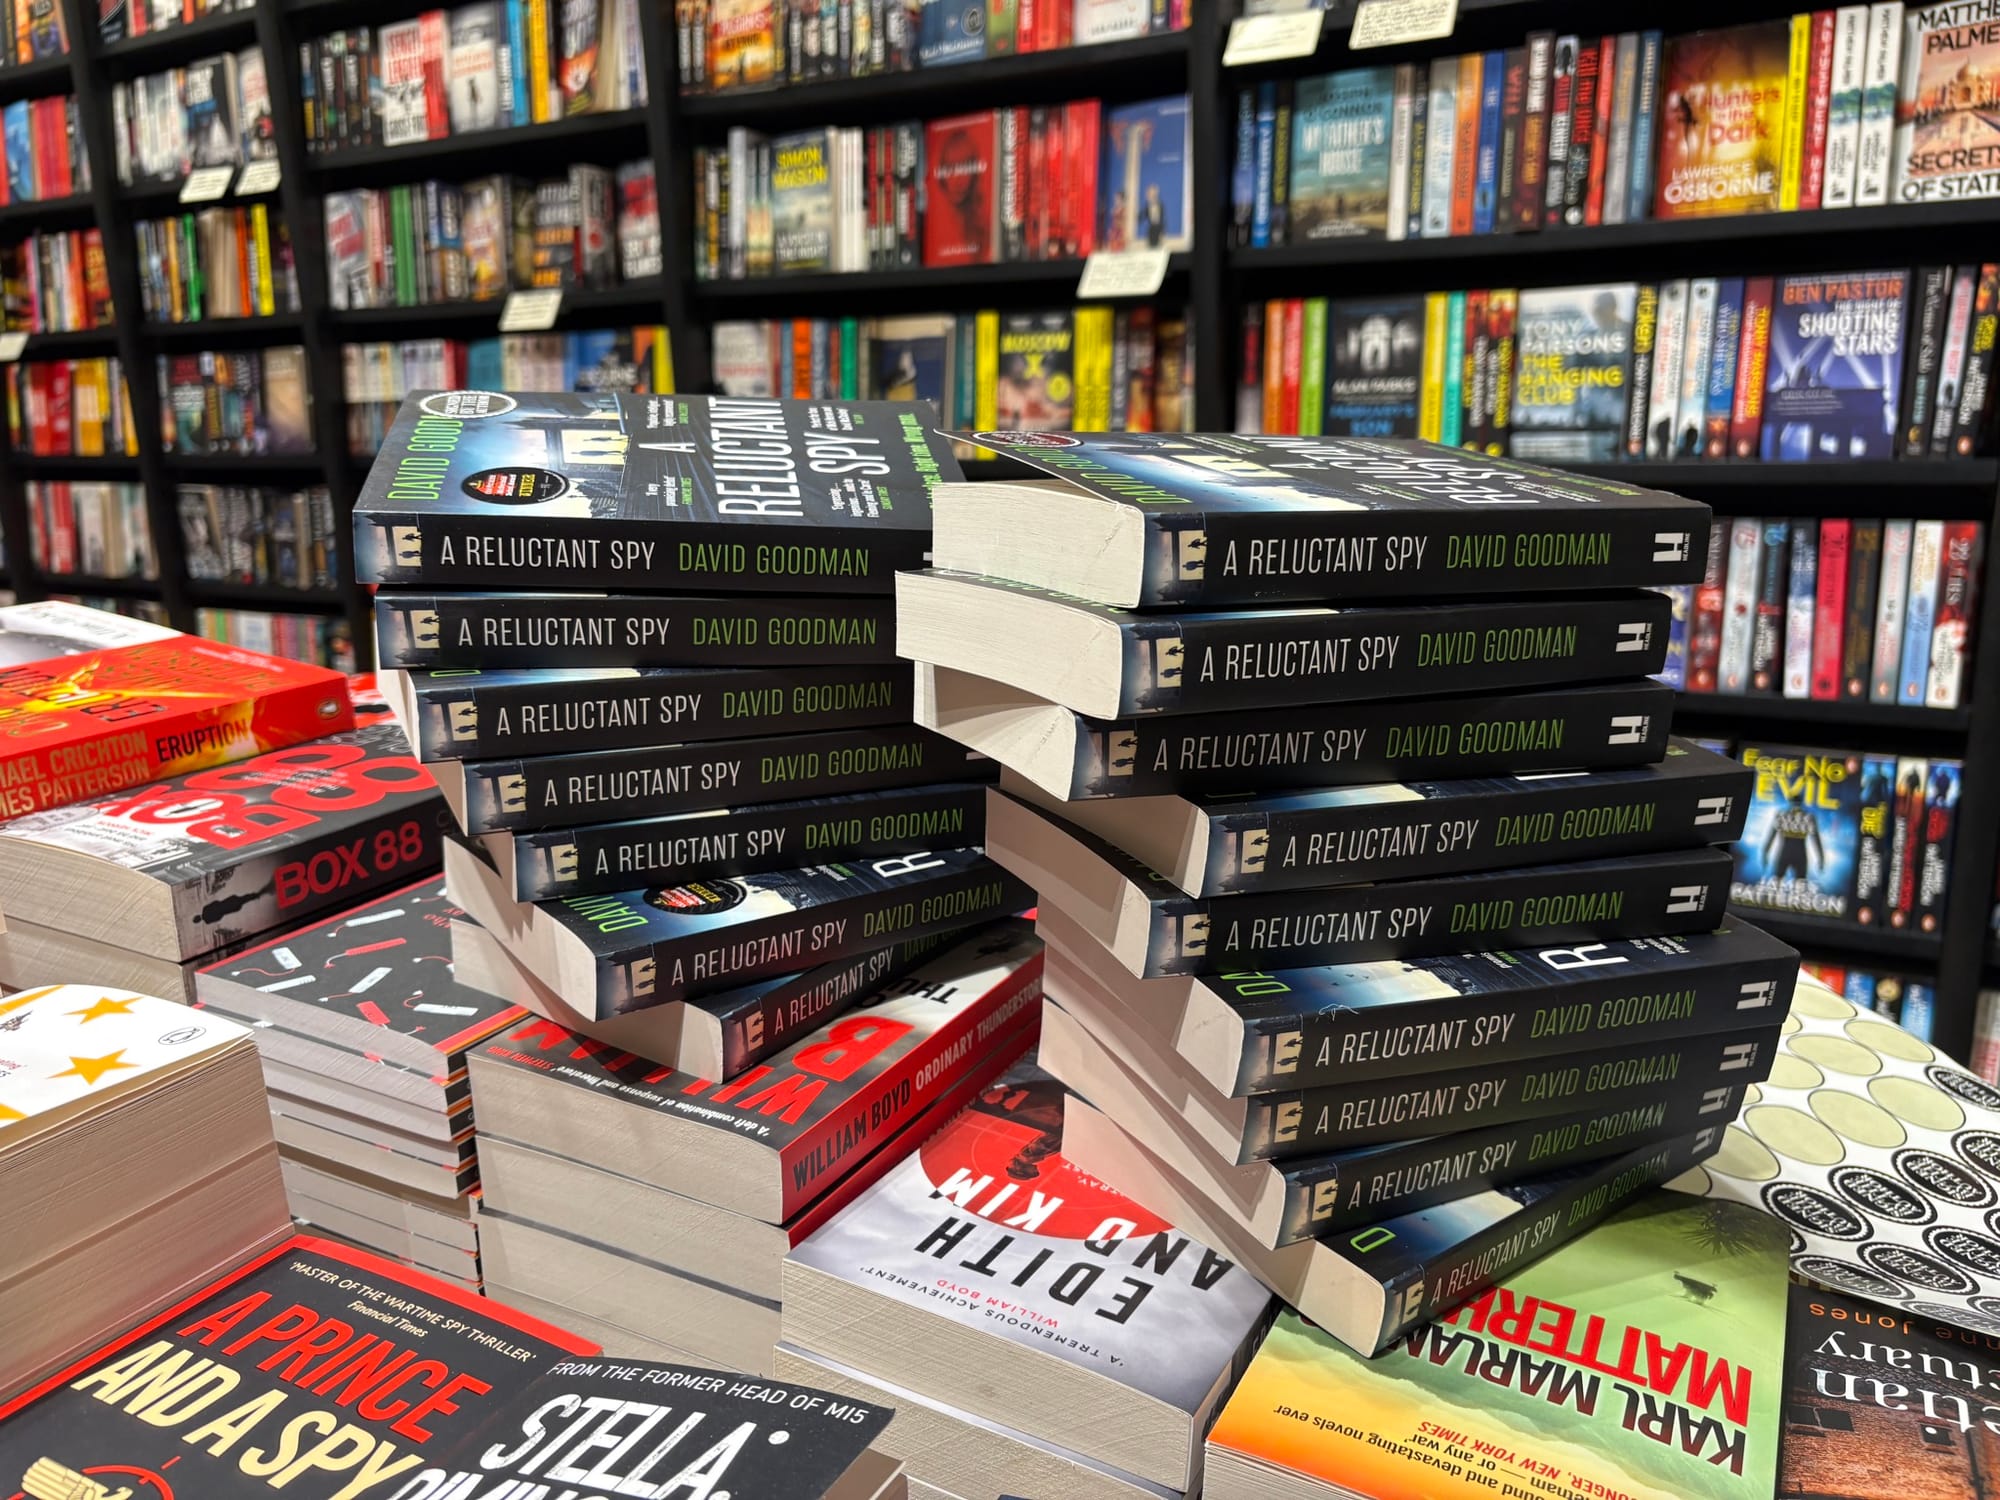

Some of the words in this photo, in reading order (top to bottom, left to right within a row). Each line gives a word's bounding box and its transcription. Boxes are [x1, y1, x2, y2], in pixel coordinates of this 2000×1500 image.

[1917, 0, 2000, 31] MATTHE
[1926, 24, 2000, 54] PALME
[1664, 171, 1774, 204] OSBORNE
[1672, 160, 1753, 181] LAWRENCE
[1901, 180, 1936, 201] OF
[1783, 282, 1822, 305] BEN
[1825, 277, 1904, 301] PASTOR
[1522, 320, 1583, 341] TONY
[1798, 310, 1900, 338] SHOOTING
[1519, 331, 1627, 356] PARSONS
[1833, 332, 1899, 356] STARS
[1518, 365, 1624, 389] HANGING
[407, 414, 465, 452] GOOD
[638, 441, 696, 454] A
[708, 396, 804, 517] RELUCTANT
[803, 431, 891, 476] SPY
[387, 456, 451, 500] DAVID
[1080, 472, 1193, 504] DAVID
[440, 535, 456, 565] A
[465, 535, 601, 569] RELUCTANT
[610, 540, 656, 570] SPY
[679, 542, 746, 573] DAVID
[756, 545, 869, 577] GOODMAN
[1223, 539, 1237, 577] A
[1248, 536, 1379, 576] RELUCTANT
[1384, 535, 1428, 572] SPY
[1446, 534, 1507, 569] DAVID
[1514, 532, 1611, 568] GOODMAN
[458, 617, 473, 647] A
[483, 617, 617, 646] RELUCTANT
[626, 617, 670, 646] SPY
[693, 617, 758, 645] DAVID
[768, 617, 876, 645] GOODMAN
[1417, 631, 1476, 667] DAVID
[1483, 625, 1577, 663] GOODMAN
[1199, 646, 1214, 683] A
[1225, 638, 1352, 681] RELUCTANT
[1357, 635, 1400, 672] SPY
[49, 728, 148, 777] CRICHTON
[154, 718, 250, 764] ERUPTION
[1743, 747, 1800, 778] Fear
[1804, 754, 1847, 783] No
[38, 754, 152, 813] PATTERSON
[1755, 773, 1841, 810] EVIL
[1495, 812, 1555, 847] DAVID
[1559, 802, 1656, 841] GOODMAN
[1282, 835, 1296, 868] A
[1306, 823, 1433, 865] RELUCTANT
[1436, 819, 1480, 853] SPY
[272, 838, 371, 910] BOX
[373, 820, 424, 872] 88
[562, 895, 649, 933] DAVI
[863, 903, 914, 938] DAVID
[920, 881, 1002, 924] GOODMAN
[1730, 882, 1846, 915] PATTERSON
[671, 958, 684, 986] A
[694, 928, 805, 981] RELUCTANT
[810, 918, 847, 951] SPY
[1530, 1003, 1593, 1039] DAVID
[1596, 989, 1697, 1030] GOODMAN
[1315, 1036, 1330, 1067] A
[1339, 1019, 1468, 1064] RELUCTANT
[1471, 1012, 1516, 1047] SPY
[597, 1078, 621, 1093] and
[618, 1084, 665, 1104] suspense
[659, 1097, 677, 1108] of
[675, 1101, 736, 1124] combination
[793, 1109, 868, 1193] WILLIAM
[871, 1077, 911, 1131] BOYD
[915, 1028, 974, 1091] ORDINARY
[930, 1166, 1064, 1229] KIM
[914, 1216, 1155, 1325] EDITH
[1084, 1217, 1236, 1291] AND
[859, 1265, 979, 1313] ACHIEVEMENT'
[936, 1279, 982, 1302] BOYD
[176, 1290, 273, 1347] A
[288, 1259, 338, 1288] 'MASTER
[338, 1279, 356, 1297] OF
[356, 1284, 382, 1309] THE
[381, 1293, 443, 1328] WARTIME
[443, 1315, 470, 1337] SPY
[468, 1325, 538, 1363] THRILLER'
[347, 1299, 395, 1327] Financial
[390, 1315, 430, 1339] Times
[986, 1294, 1058, 1329] WILLIAM
[1808, 1302, 1915, 1336] Jones
[985, 1308, 1101, 1358] TREMENDOUS
[222, 1304, 494, 1443] PRINCE
[1110, 1353, 1127, 1368] 'A
[1814, 1331, 2000, 1392] ctuary
[551, 1361, 602, 1380] FROM
[601, 1365, 640, 1381] THE
[638, 1369, 726, 1395] FORMER
[726, 1382, 789, 1406] HEAD
[789, 1394, 820, 1410] OF
[822, 1403, 870, 1425] MI5
[1810, 1367, 2000, 1433] etian
[71, 1340, 241, 1428] AND
[182, 1388, 288, 1458] A
[238, 1410, 426, 1500] SPY
[1274, 1402, 1310, 1425] ever
[1311, 1415, 1364, 1441] novels
[1621, 1383, 1747, 1478] KARL
[479, 1394, 757, 1500] STELLA
[1402, 1434, 1441, 1454] war'
[1417, 1420, 1469, 1447] TIMES
[1366, 1431, 1462, 1478] devastating
[1442, 1444, 1475, 1465] any
[1471, 1440, 1518, 1465] YORK
[1476, 1457, 1497, 1472] or
[1518, 1458, 1561, 1481] NEW
[1465, 1467, 1499, 1491] and
[1568, 1472, 1636, 1500] UNGER,
